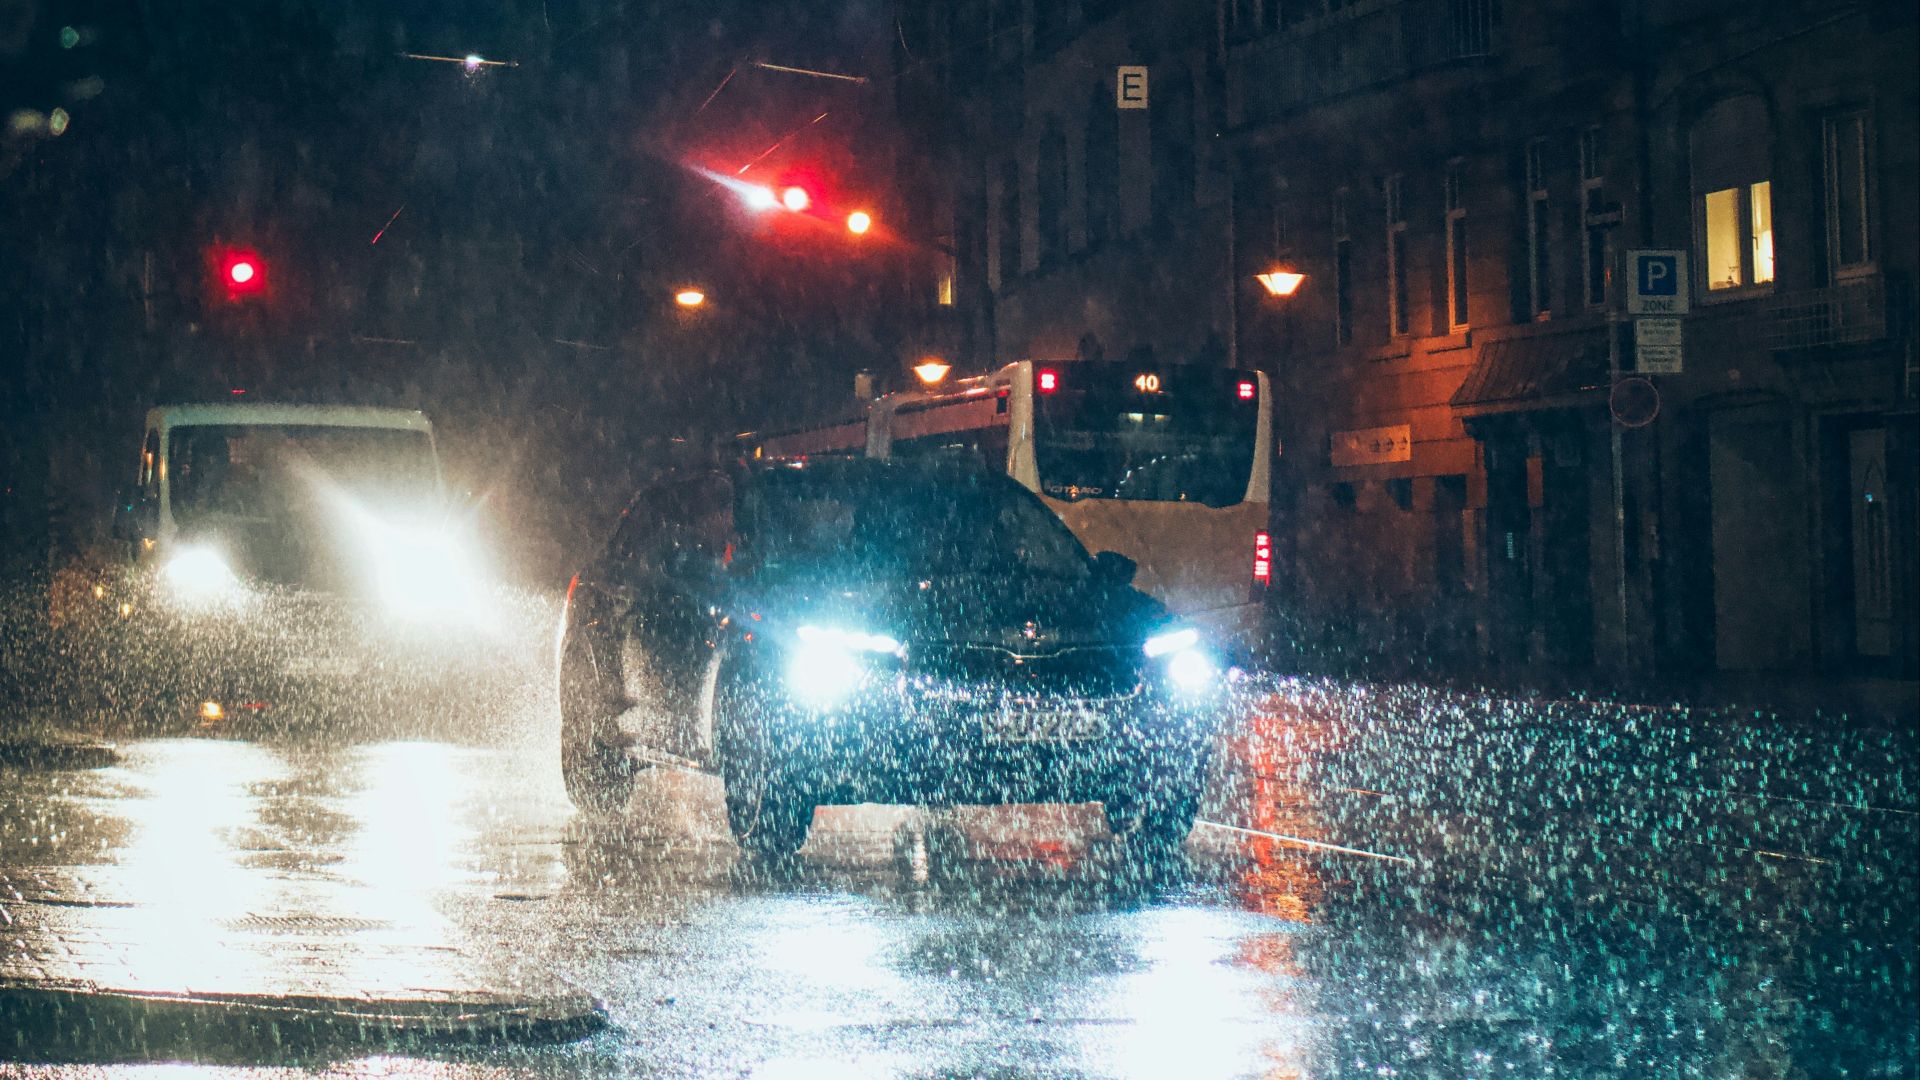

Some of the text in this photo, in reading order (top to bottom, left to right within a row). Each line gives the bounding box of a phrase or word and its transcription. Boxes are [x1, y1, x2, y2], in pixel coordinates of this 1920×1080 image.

[1122, 73, 1142, 101] E
[1647, 261, 1667, 290] P
[1642, 300, 1676, 312] ZONE
[1134, 373, 1159, 392] 40
